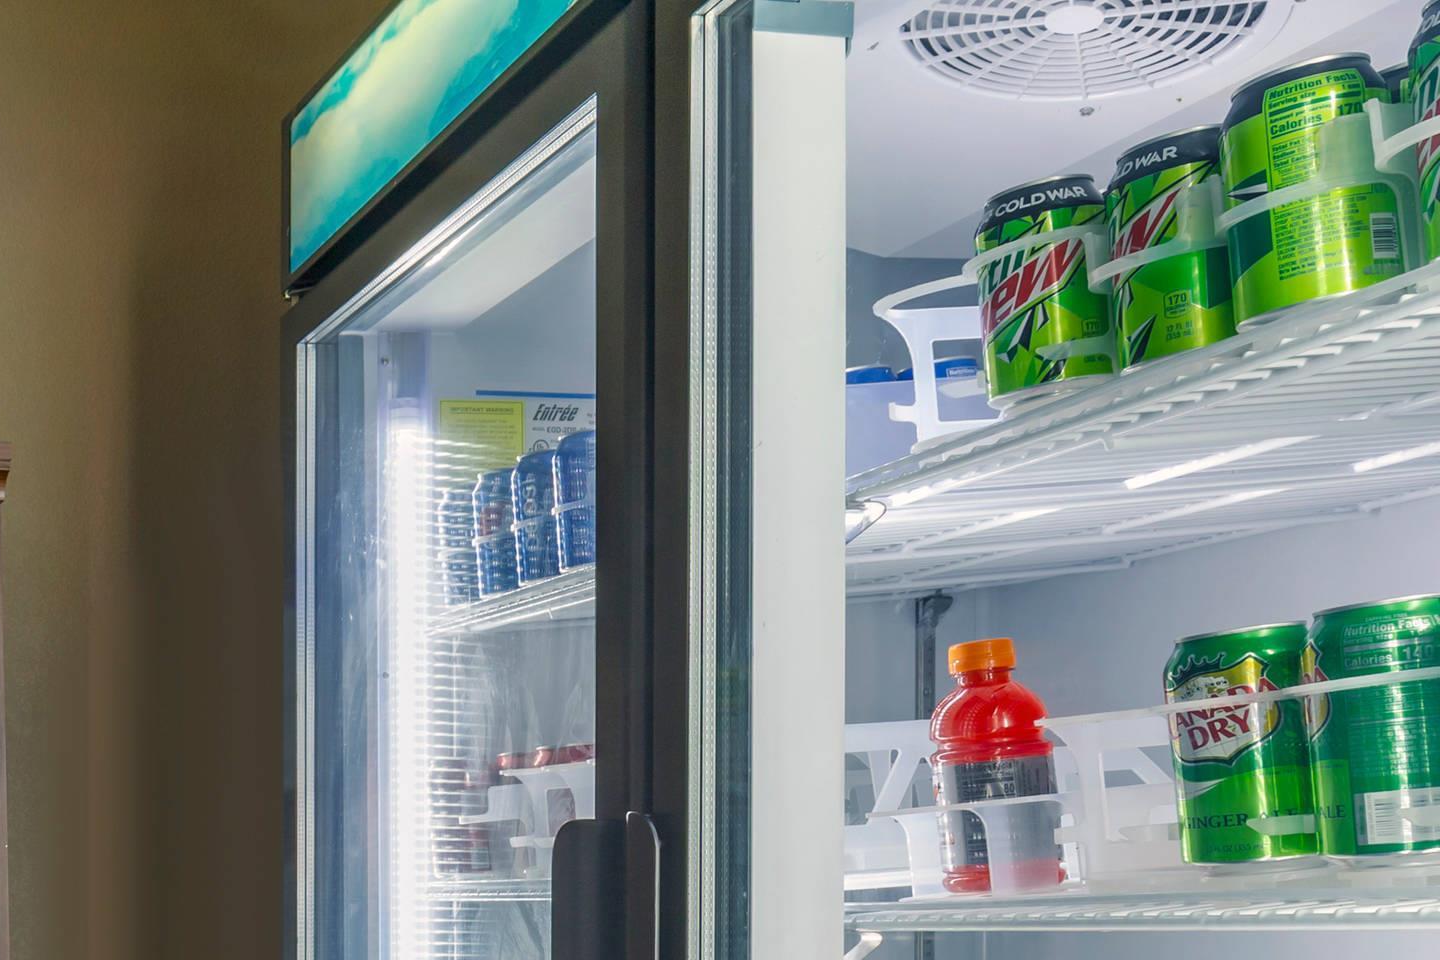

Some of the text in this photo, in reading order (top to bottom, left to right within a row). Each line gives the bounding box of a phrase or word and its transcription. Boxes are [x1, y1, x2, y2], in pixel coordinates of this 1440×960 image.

[1269, 73, 1358, 99] Nutrition Facts
[1270, 114, 1323, 136] Calories
[1135, 146, 1178, 169] WAR
[994, 185, 1089, 217] COLD WAR
[1167, 292, 1187, 305] 170
[532, 403, 579, 422] Entrée
[1343, 622, 1395, 637] Nutrition
[1344, 653, 1393, 667] Calories
[1402, 644, 1434, 660] 140
[1187, 708, 1251, 751] DRY
[1003, 783, 1015, 793] 80
[1182, 813, 1249, 830] GINGER
